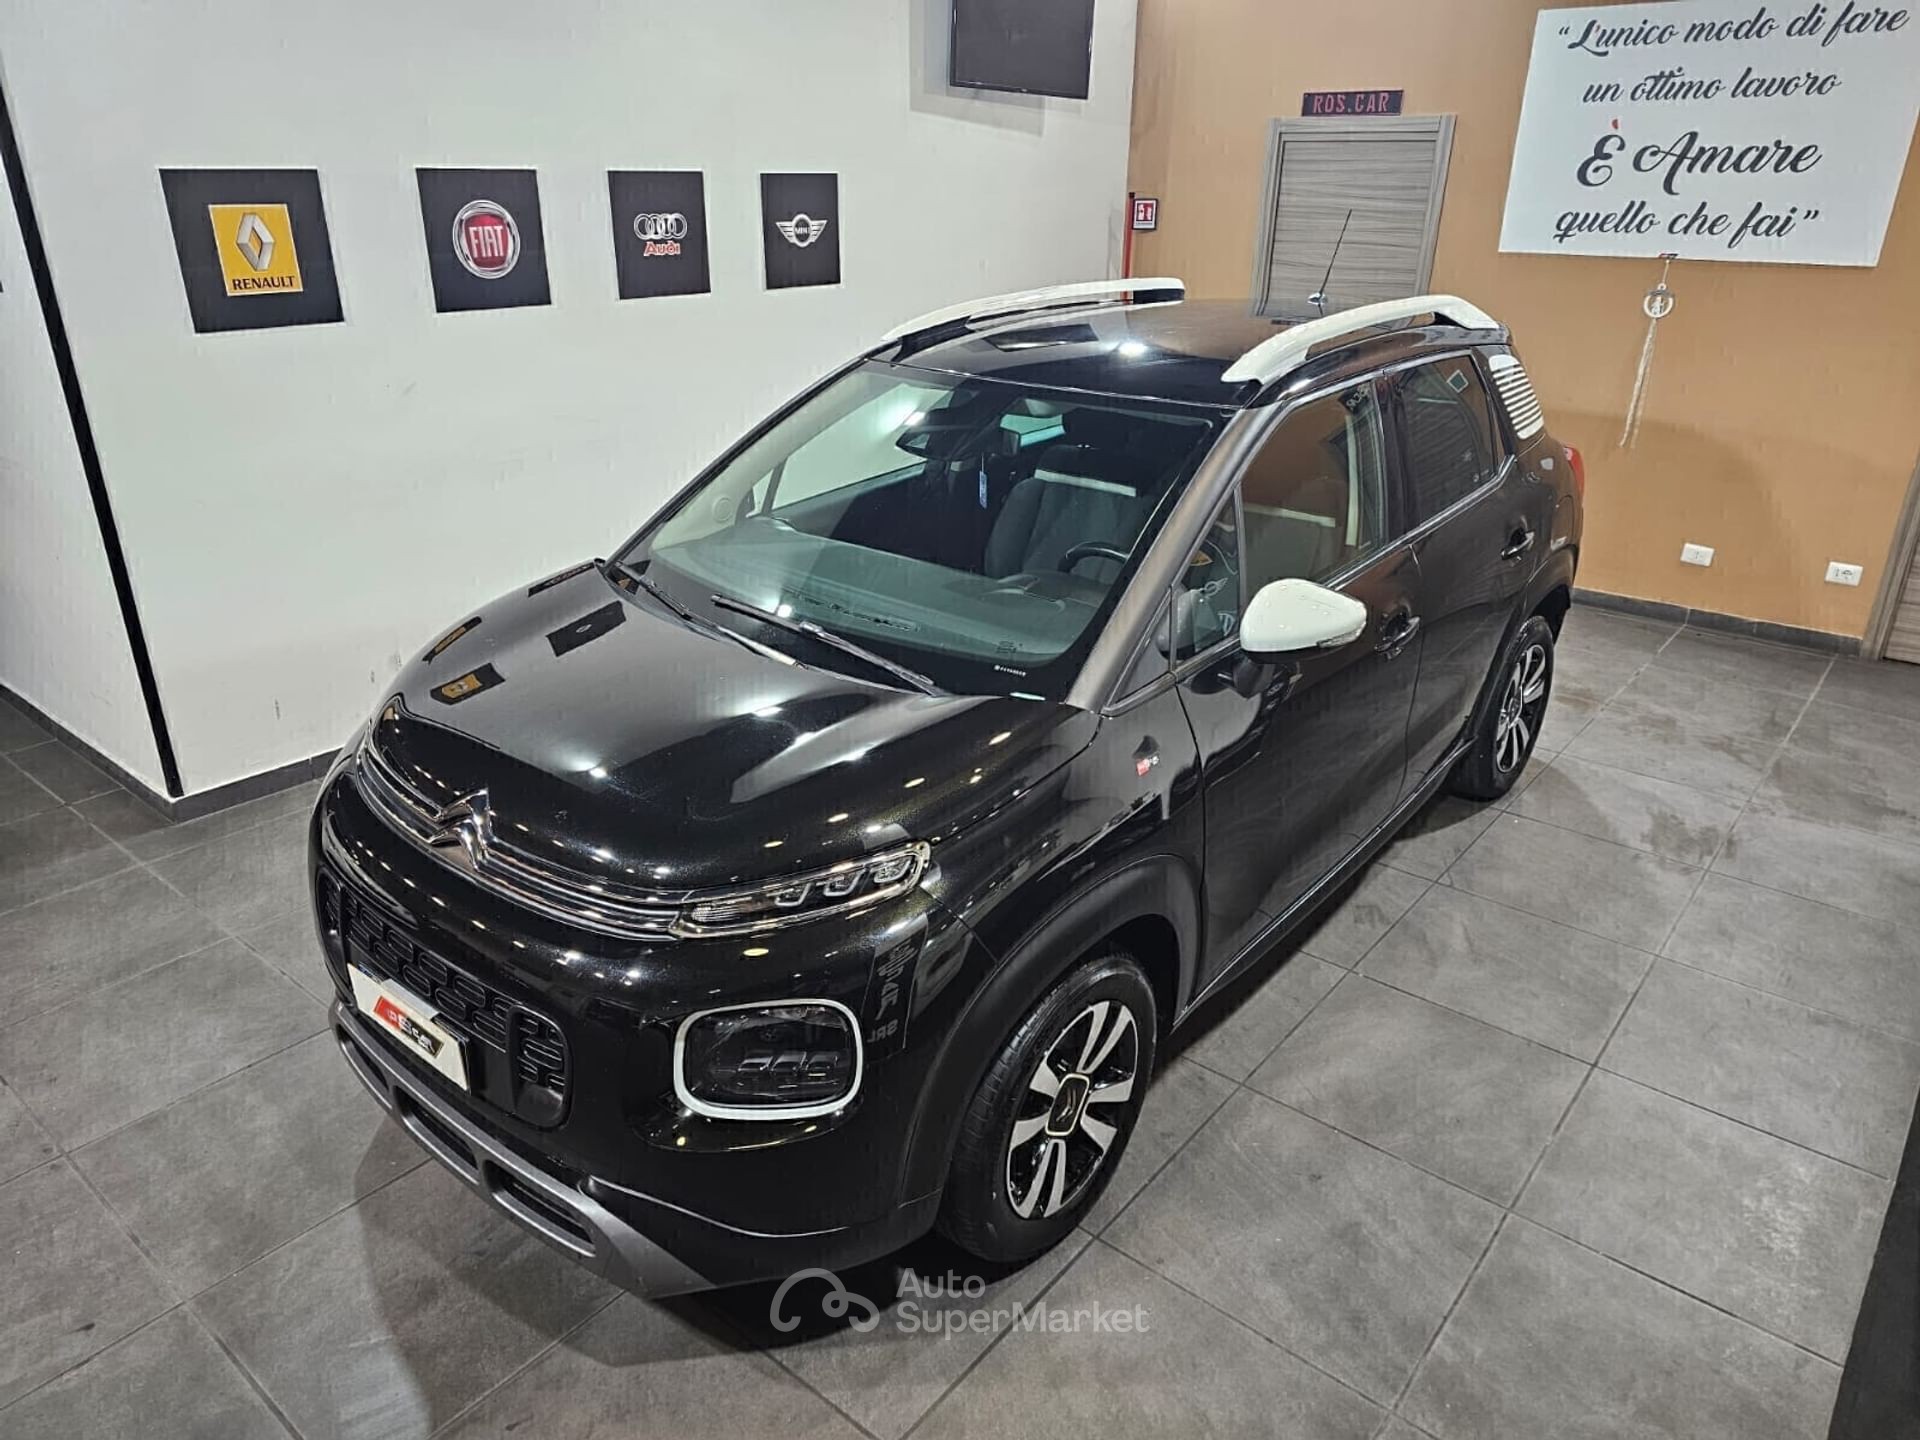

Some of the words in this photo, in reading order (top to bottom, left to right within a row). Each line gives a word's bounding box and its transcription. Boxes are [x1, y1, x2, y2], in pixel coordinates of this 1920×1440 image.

[1684, 7, 1780, 43] modo
[1786, 3, 1827, 37] di
[1821, 1, 1910, 47] fare
[1582, 82, 1624, 103] un
[1630, 66, 1725, 102] ottimo
[1730, 66, 1842, 99] lavoro
[1313, 92, 1390, 113] ROS.CAR
[1576, 118, 1626, 188] È
[1632, 131, 1823, 196] Amare
[1553, 200, 1660, 244] quello
[1667, 201, 1731, 238] che
[468, 224, 504, 258] FIAT
[643, 240, 681, 256] Audi
[231, 275, 295, 290] RENAULT
